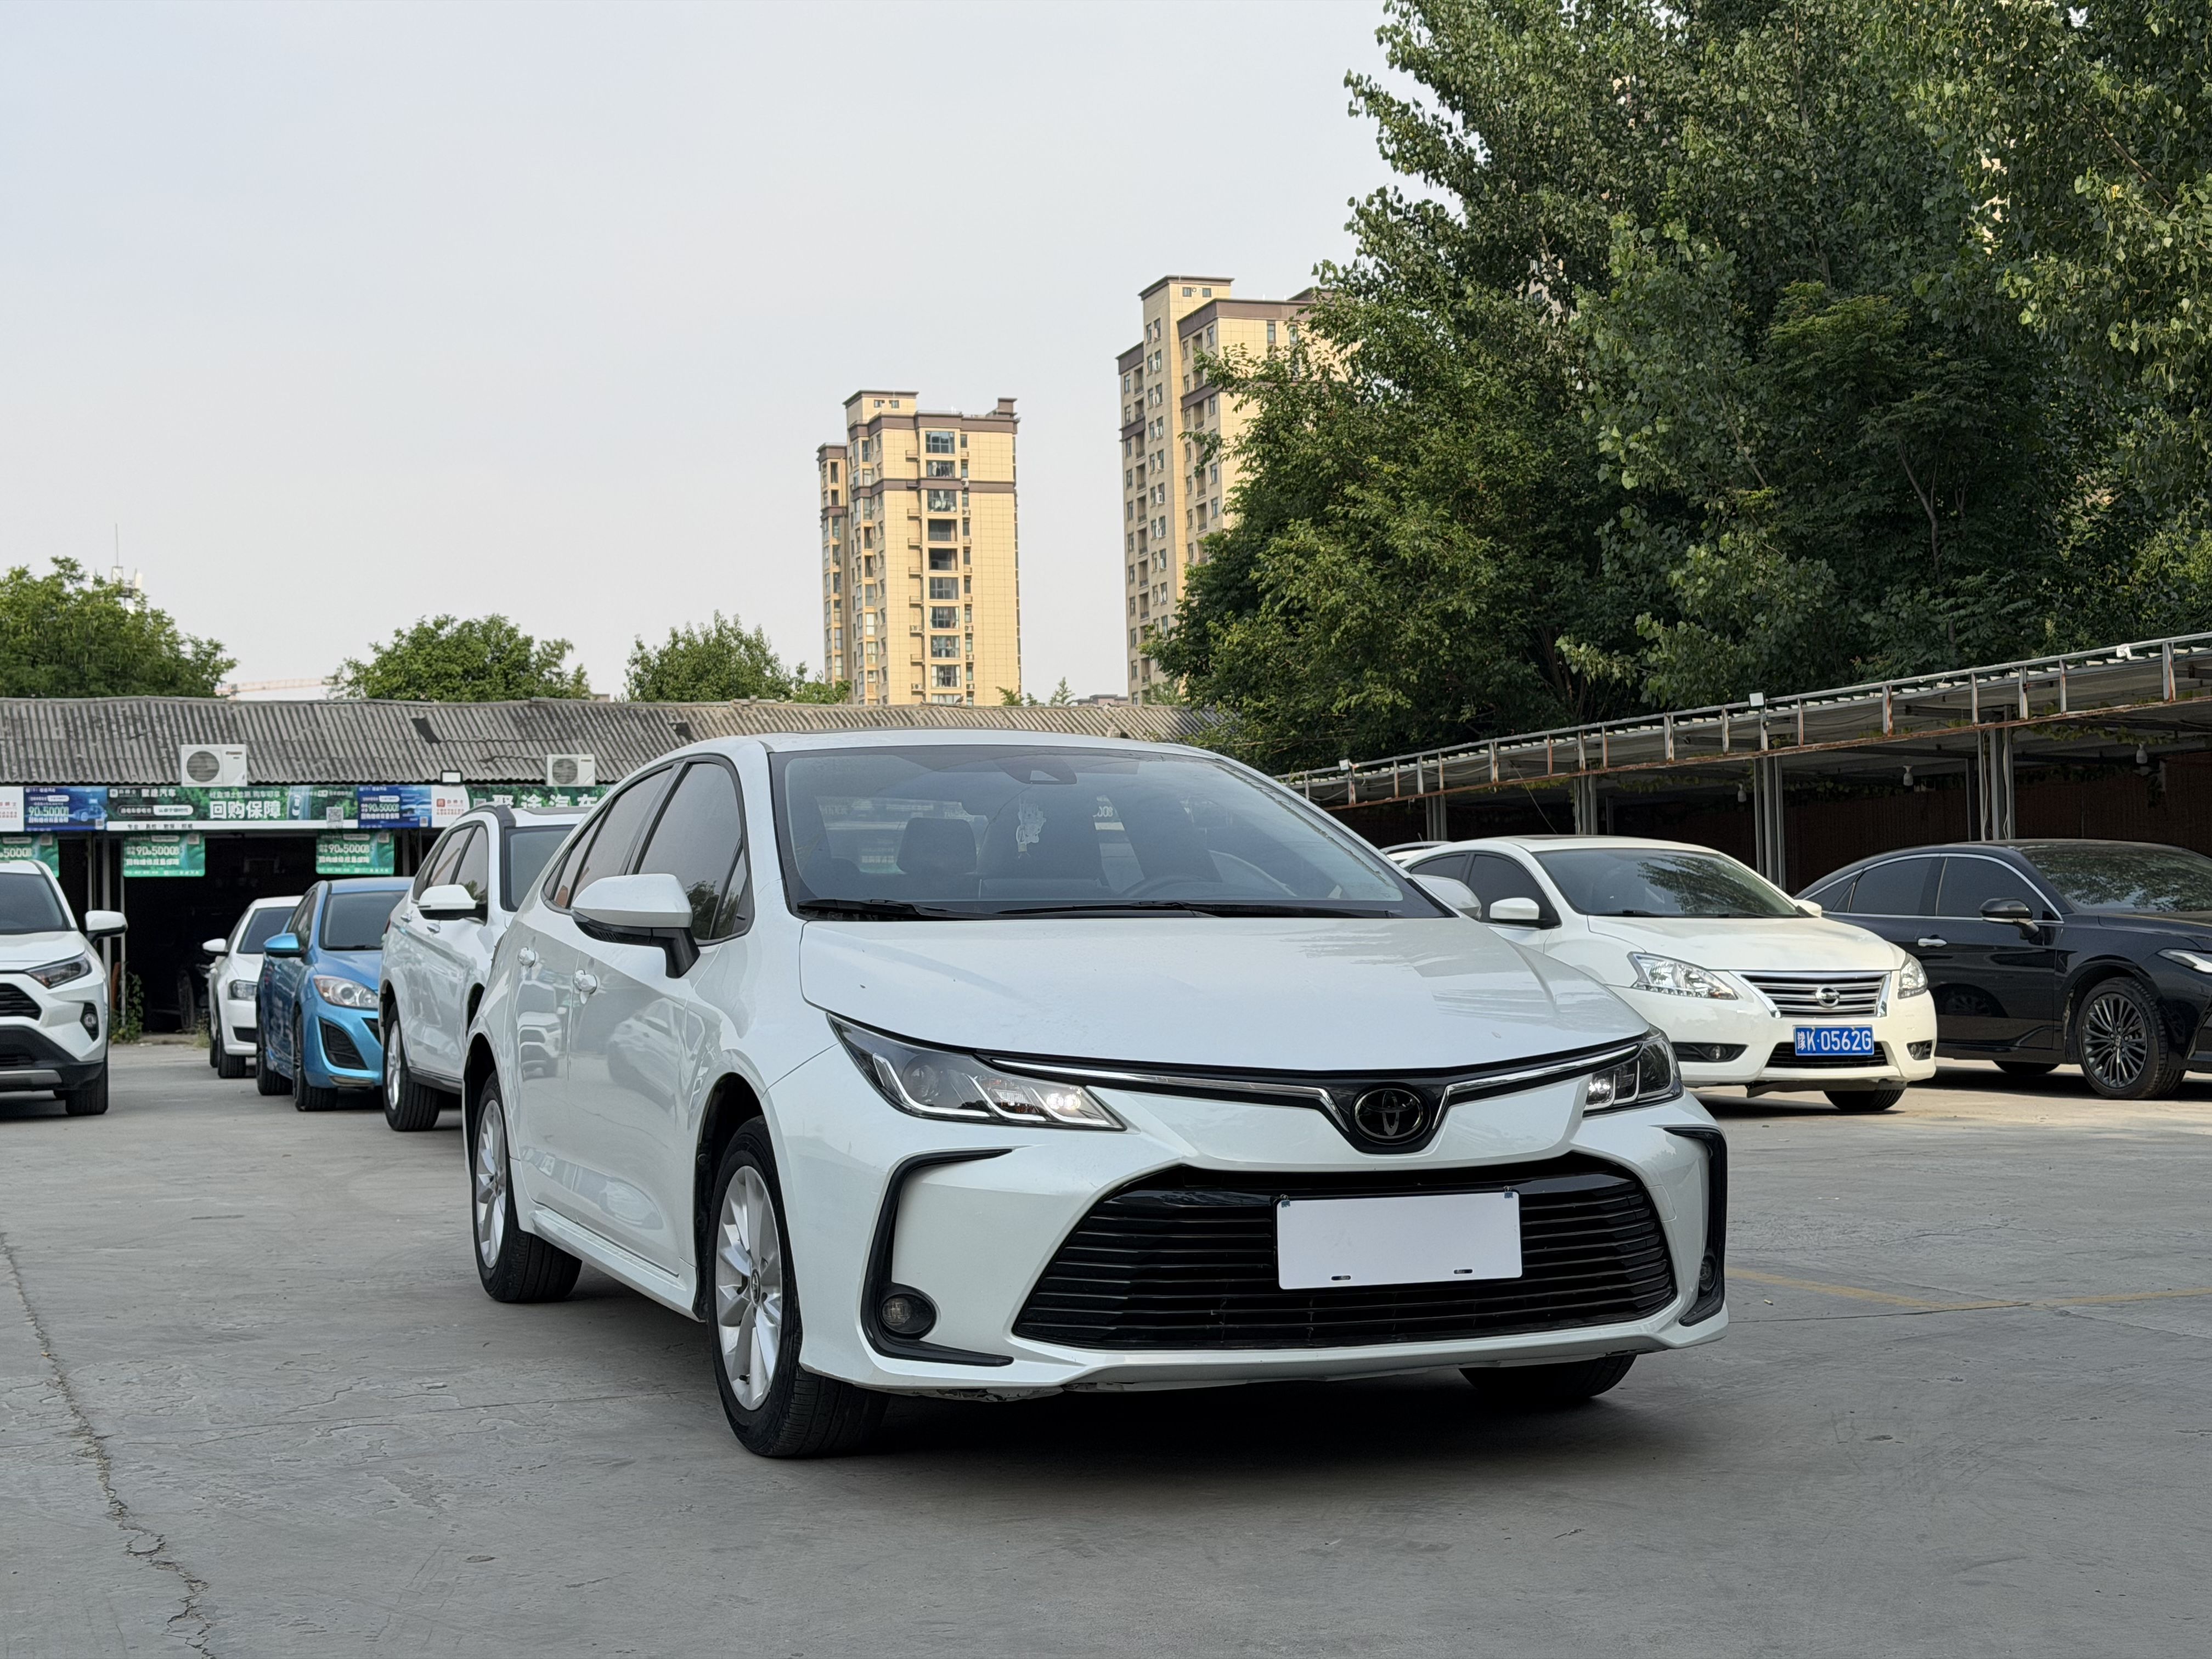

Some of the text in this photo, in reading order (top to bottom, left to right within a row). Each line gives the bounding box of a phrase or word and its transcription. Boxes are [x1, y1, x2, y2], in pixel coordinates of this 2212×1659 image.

[210, 800, 281, 819] 回购保障
[1797, 1030, 1871, 1051] 豫K·0562G
